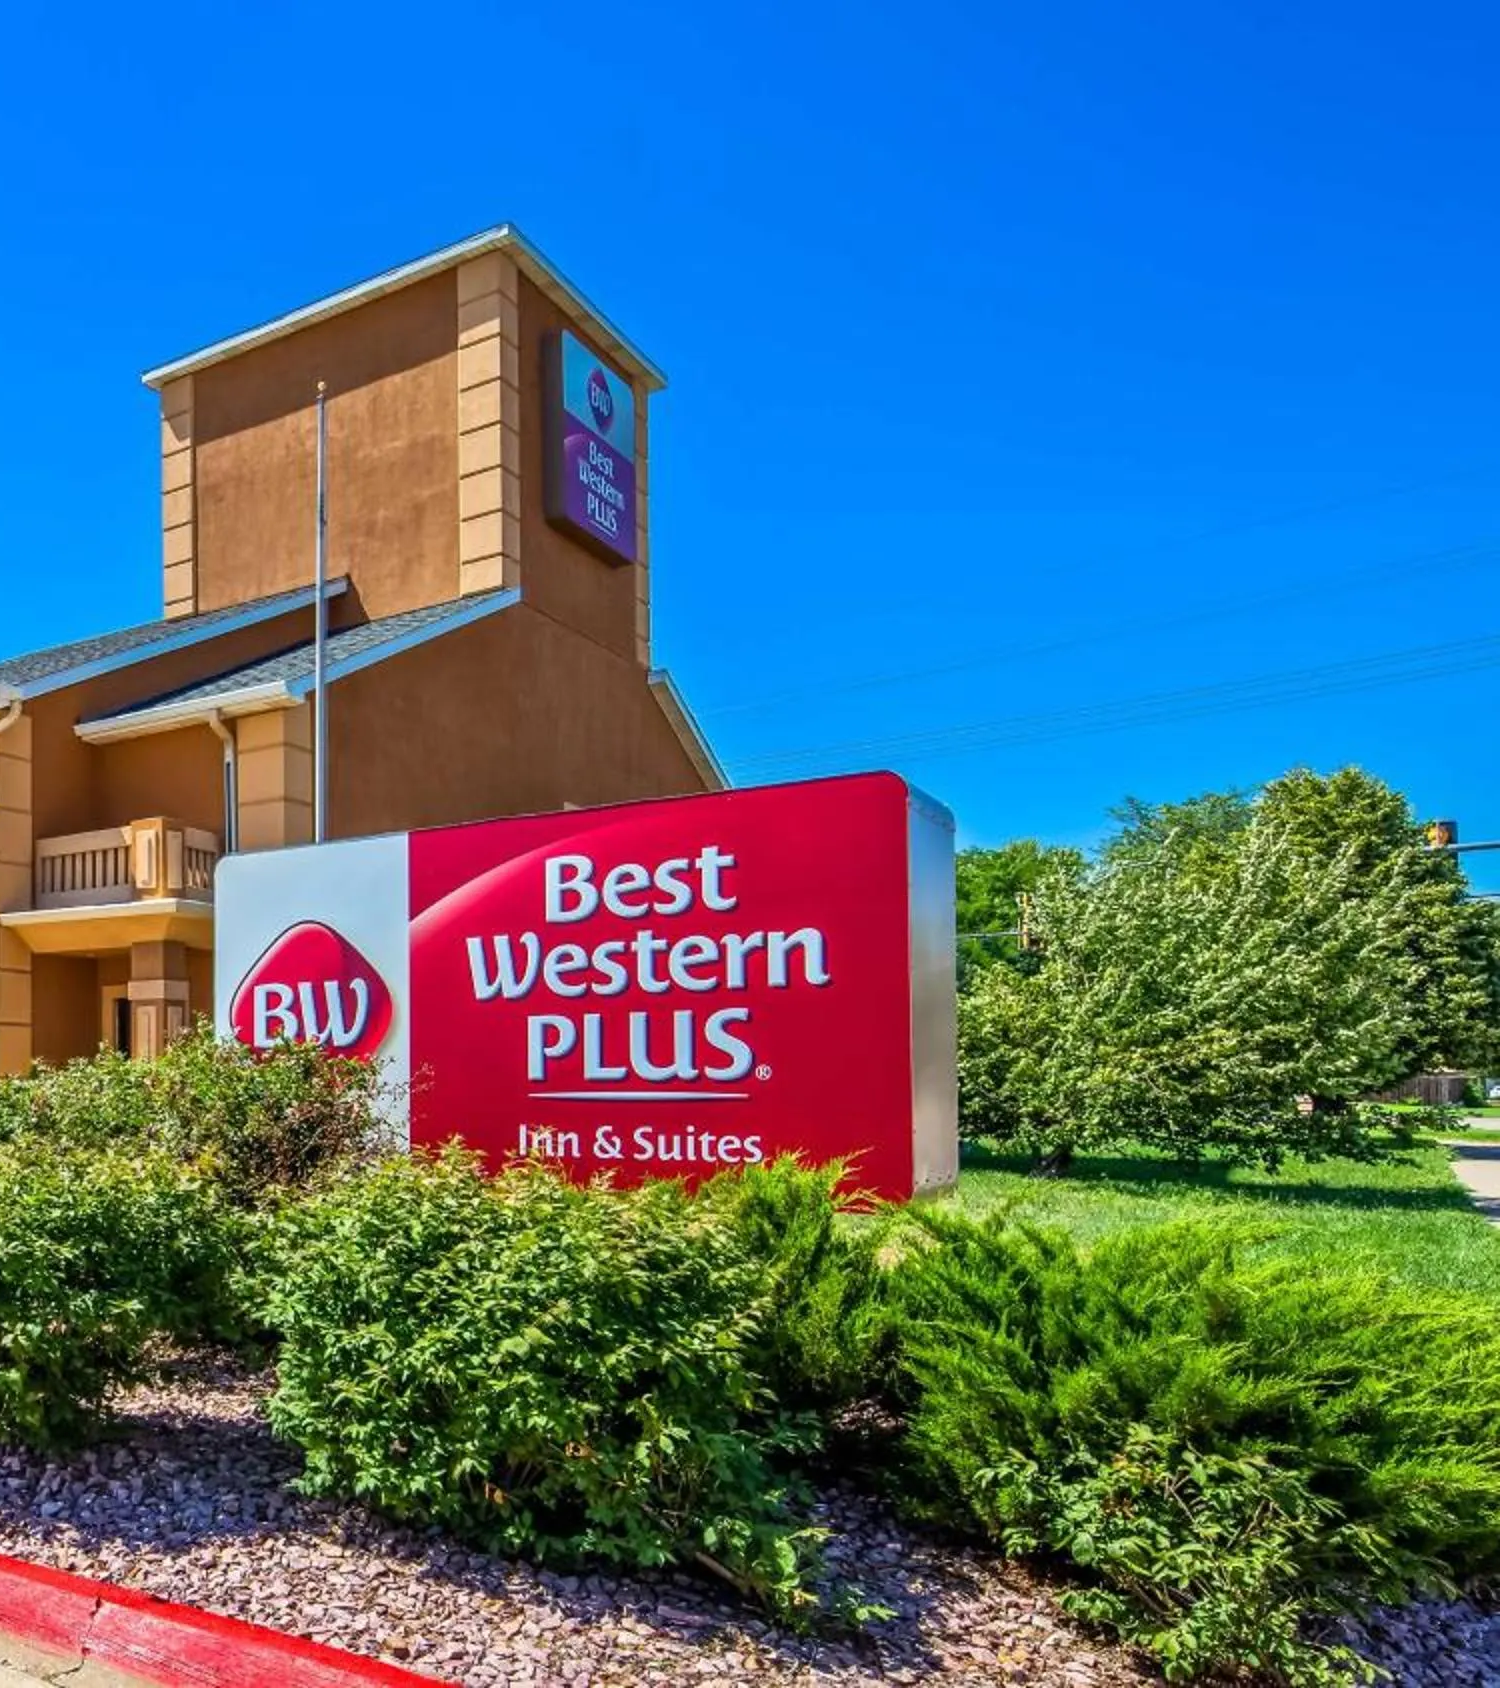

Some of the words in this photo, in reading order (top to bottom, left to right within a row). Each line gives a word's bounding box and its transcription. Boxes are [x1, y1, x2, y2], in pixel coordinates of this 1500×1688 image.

[591, 383, 611, 417] BW
[578, 456, 625, 511] Western
[589, 440, 614, 479] Best
[587, 492, 617, 533] PLUS
[544, 845, 738, 924] Best
[466, 926, 832, 1001] Western
[252, 977, 368, 1050] BW
[518, 1124, 581, 1159] Inn
[592, 1125, 624, 1159] &
[632, 1125, 763, 1164] Suites
